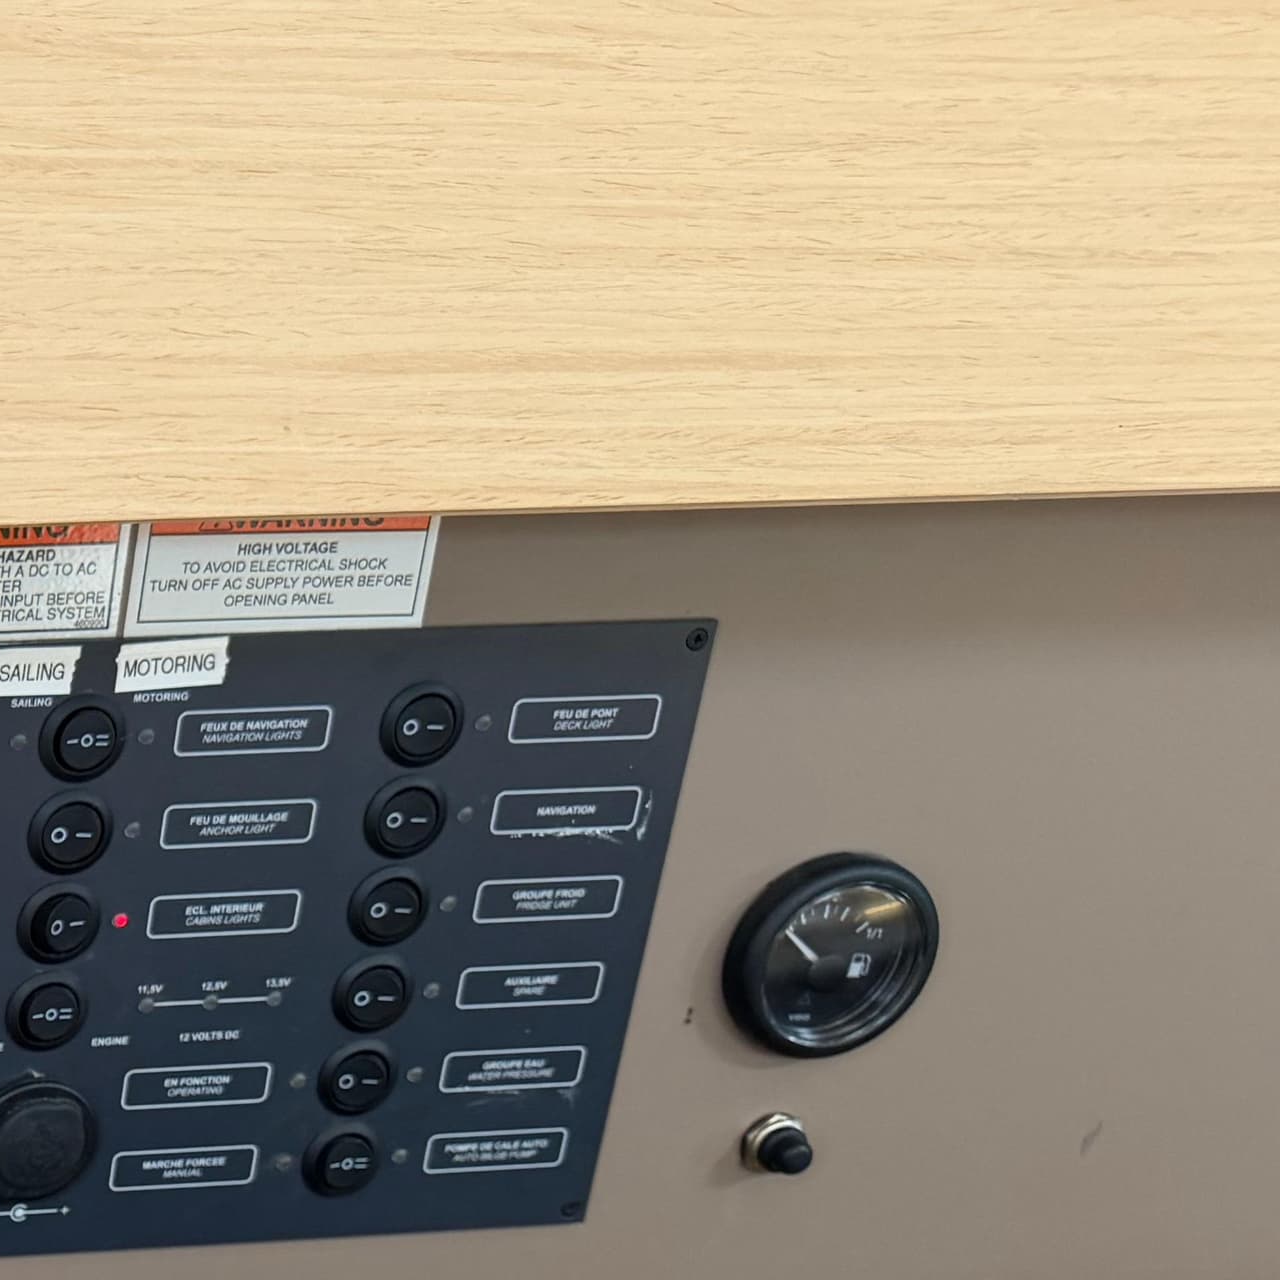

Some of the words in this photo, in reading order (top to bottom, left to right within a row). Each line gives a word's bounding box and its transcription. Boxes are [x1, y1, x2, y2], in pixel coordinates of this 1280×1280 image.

[237, 543, 272, 556] HIGH
[276, 541, 339, 555] VOLTAGE
[14, 564, 25, 578] A
[28, 564, 50, 577] DC
[53, 562, 74, 576] TO
[75, 561, 97, 576] AC
[182, 561, 200, 574] TO
[203, 560, 246, 573] AVOID
[249, 558, 335, 573] ELECTRICAL
[338, 558, 388, 571] SHOCK
[149, 579, 188, 592] TURN
[191, 578, 220, 591] OFF
[222, 577, 242, 591] AC
[245, 576, 300, 590] SUPPLY
[302, 575, 354, 589] POWER
[356, 574, 414, 587] BEFORE
[0, 593, 44, 608] INPUT
[46, 591, 106, 606] BEFORE
[223, 593, 288, 608] OPENING
[291, 592, 335, 606] PANEL
[46, 606, 106, 620] SYSTEM
[122, 652, 216, 679] MOTORING
[10, 697, 53, 709] SAILING
[133, 691, 190, 704] MOTORING
[553, 709, 574, 720] FEU
[574, 708, 590, 719] DE
[590, 707, 619, 719] PONT
[200, 722, 227, 733] FEUX
[229, 721, 244, 731] DE
[245, 718, 309, 730] NAVIGATION
[553, 719, 582, 732] DECK
[582, 718, 615, 730] LIGHT
[201, 732, 264, 744] NAVIGATION
[264, 730, 304, 741] LIGHTS
[536, 804, 597, 817] NAVIGATION
[189, 815, 211, 826] FEU
[212, 814, 226, 825] DE
[228, 811, 289, 824] MOUILLAGE
[199, 825, 243, 837] ANCHOR
[244, 823, 277, 835] LIGHT
[209, 901, 265, 915] INTERIEUR
[223, 912, 262, 926] LIGHTS
[90, 1035, 131, 1048] ENGINE
[178, 1032, 191, 1043] 12
[191, 1030, 224, 1042] VOLTS
[224, 1029, 241, 1041] DC
[163, 1077, 179, 1089] EN
[179, 1074, 232, 1087] FONCTION
[142, 1158, 185, 1171] MARCHE
